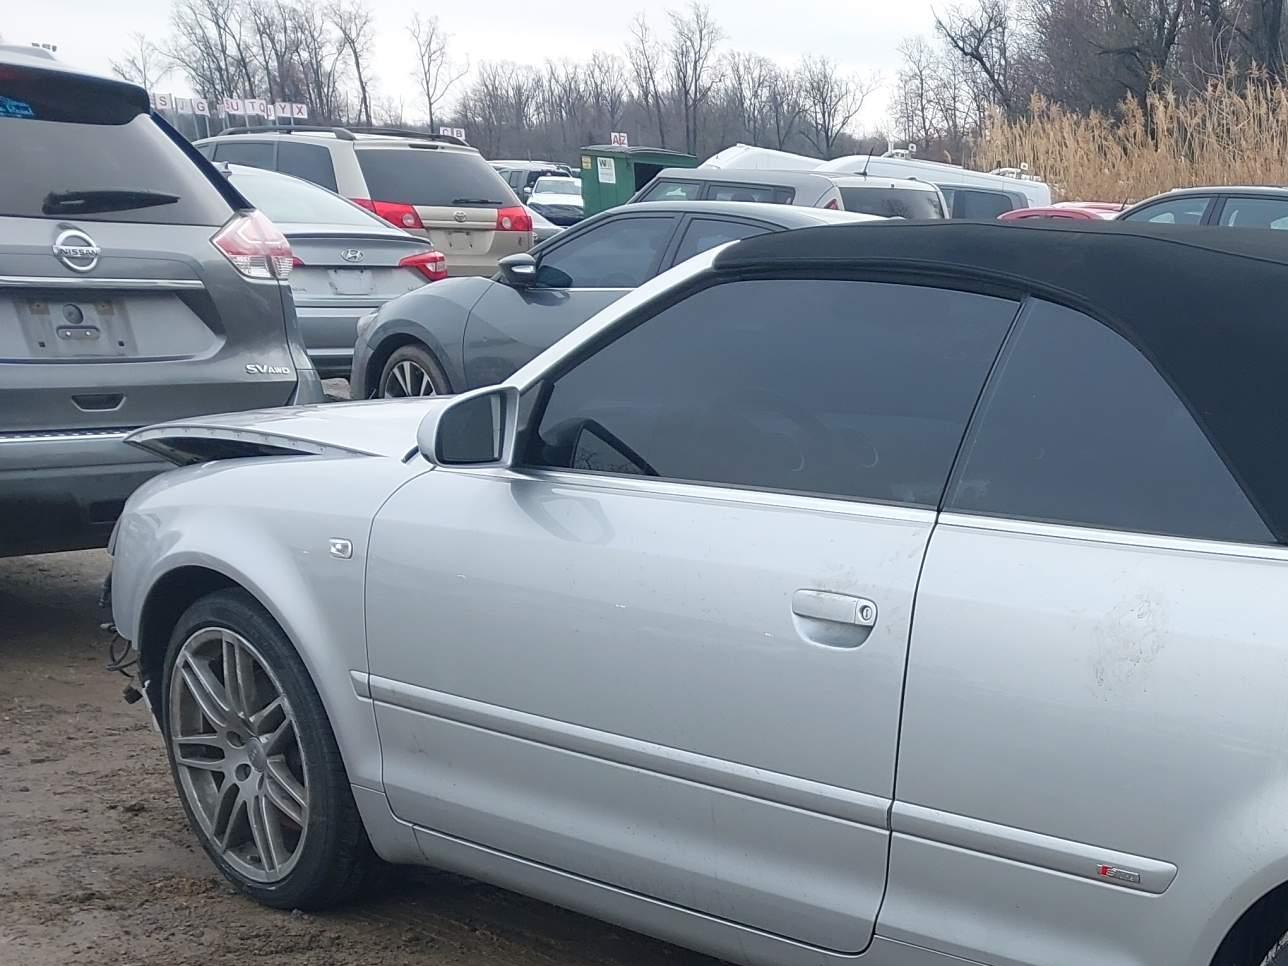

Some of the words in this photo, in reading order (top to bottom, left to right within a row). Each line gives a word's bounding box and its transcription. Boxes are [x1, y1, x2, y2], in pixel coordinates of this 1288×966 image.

[158, 95, 168, 107] S
[248, 101, 256, 111] T
[196, 102, 206, 112] G
[231, 102, 239, 112] U
[279, 104, 287, 113] Y
[296, 105, 304, 116] X
[455, 129, 463, 138] B
[613, 134, 619, 145] A
[60, 248, 98, 256] NISSAN
[246, 363, 268, 375] SV
[268, 366, 291, 375] AWD
